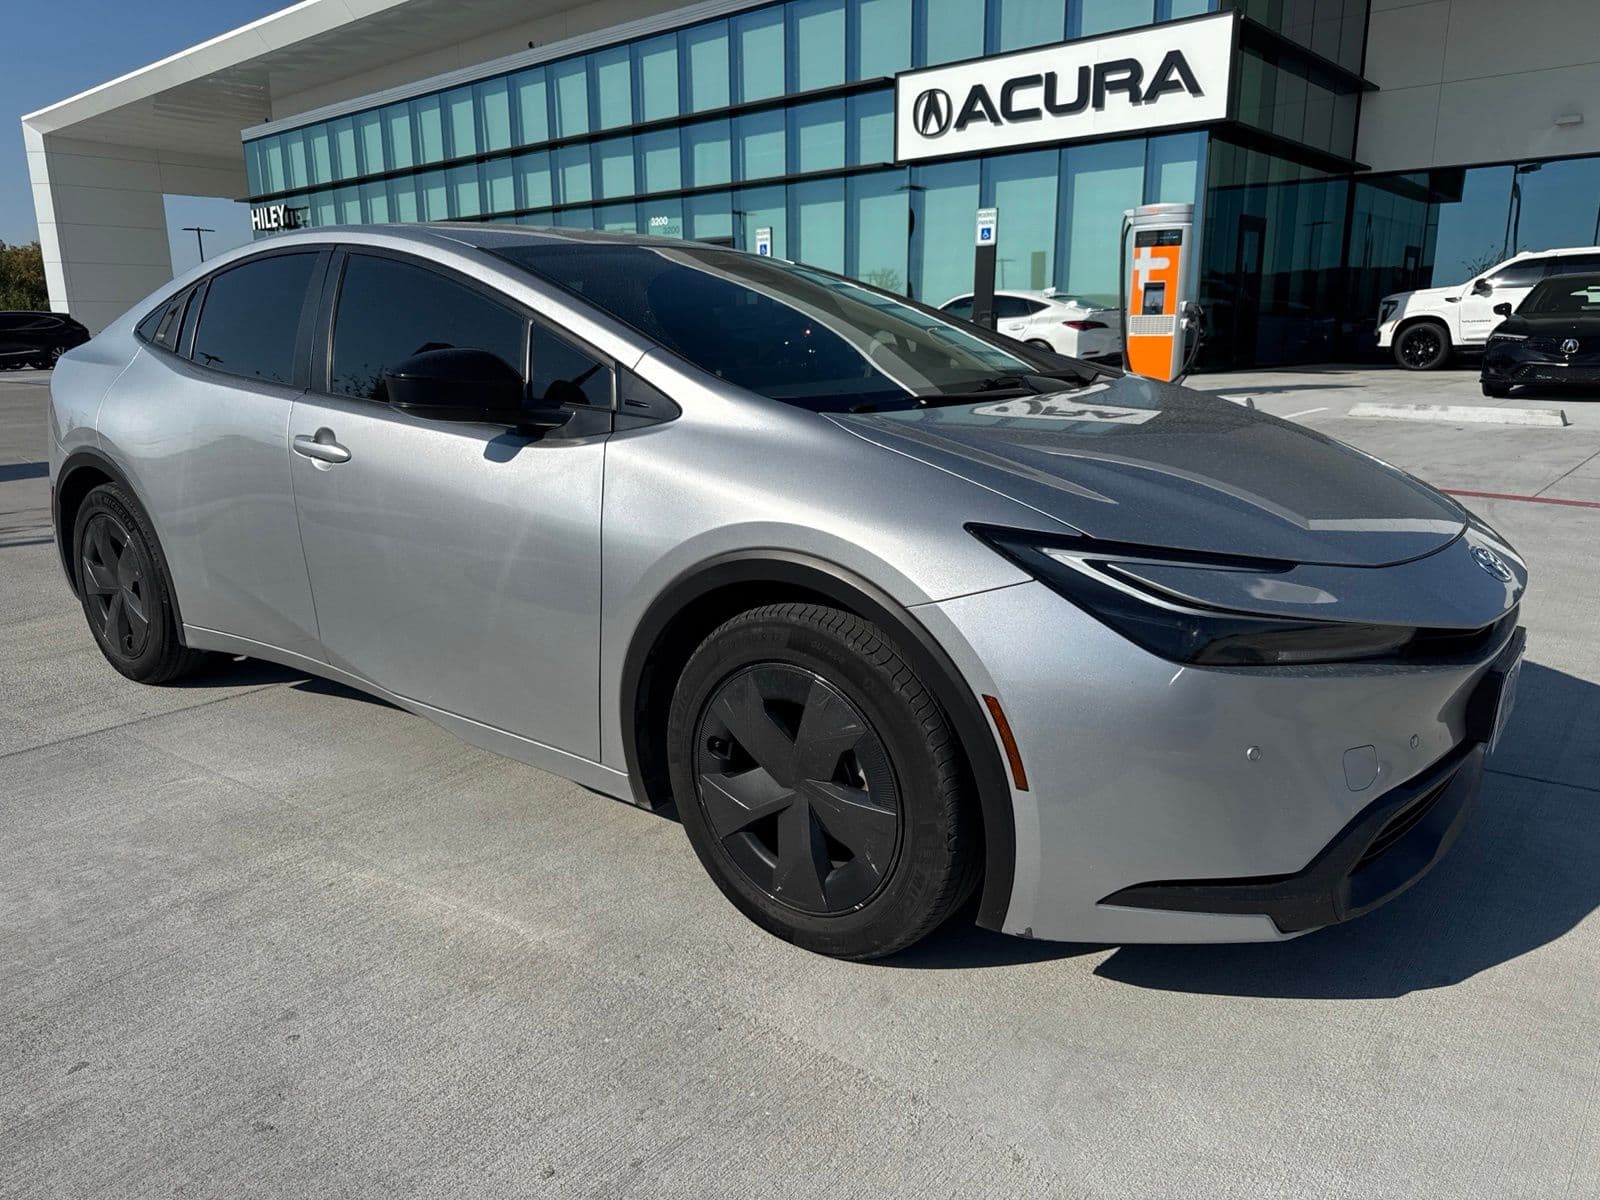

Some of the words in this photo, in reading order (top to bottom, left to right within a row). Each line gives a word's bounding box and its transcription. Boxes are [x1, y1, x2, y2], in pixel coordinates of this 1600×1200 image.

[953, 49, 1205, 131] ACURA
[250, 204, 285, 231] HILEY
[650, 215, 668, 226] 3200
